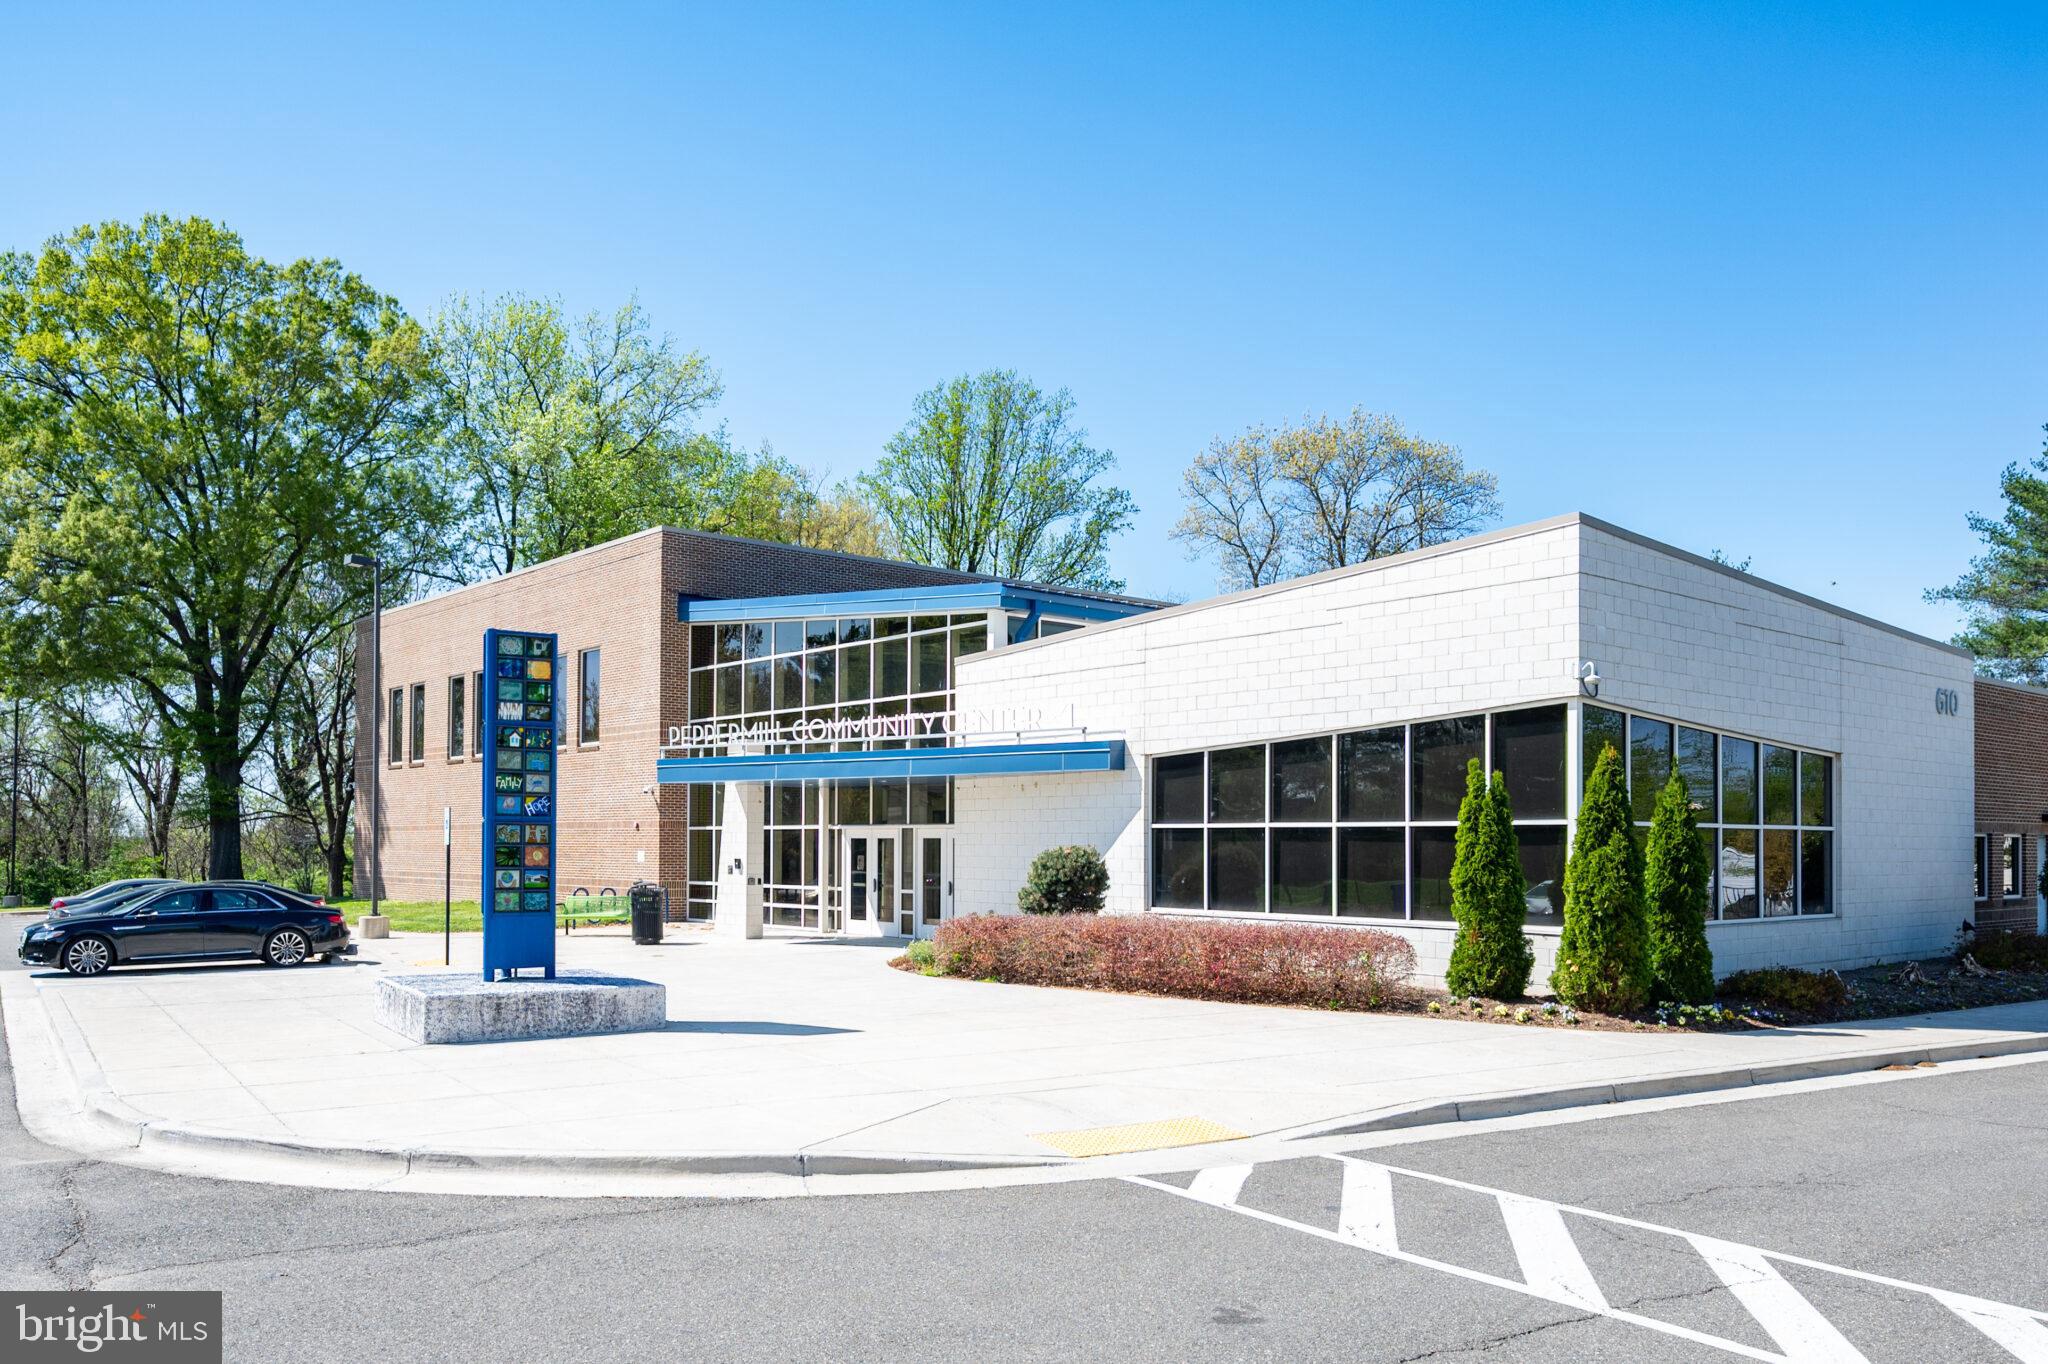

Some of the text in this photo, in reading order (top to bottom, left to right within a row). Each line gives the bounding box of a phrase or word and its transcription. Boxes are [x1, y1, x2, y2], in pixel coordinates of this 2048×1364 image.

[1936, 688, 1957, 716] 610
[669, 720, 787, 747] PEPPERMILL
[792, 713, 937, 742] COMMUNITY
[495, 776, 522, 790] FAMILY
[524, 795, 551, 816] HOPE
